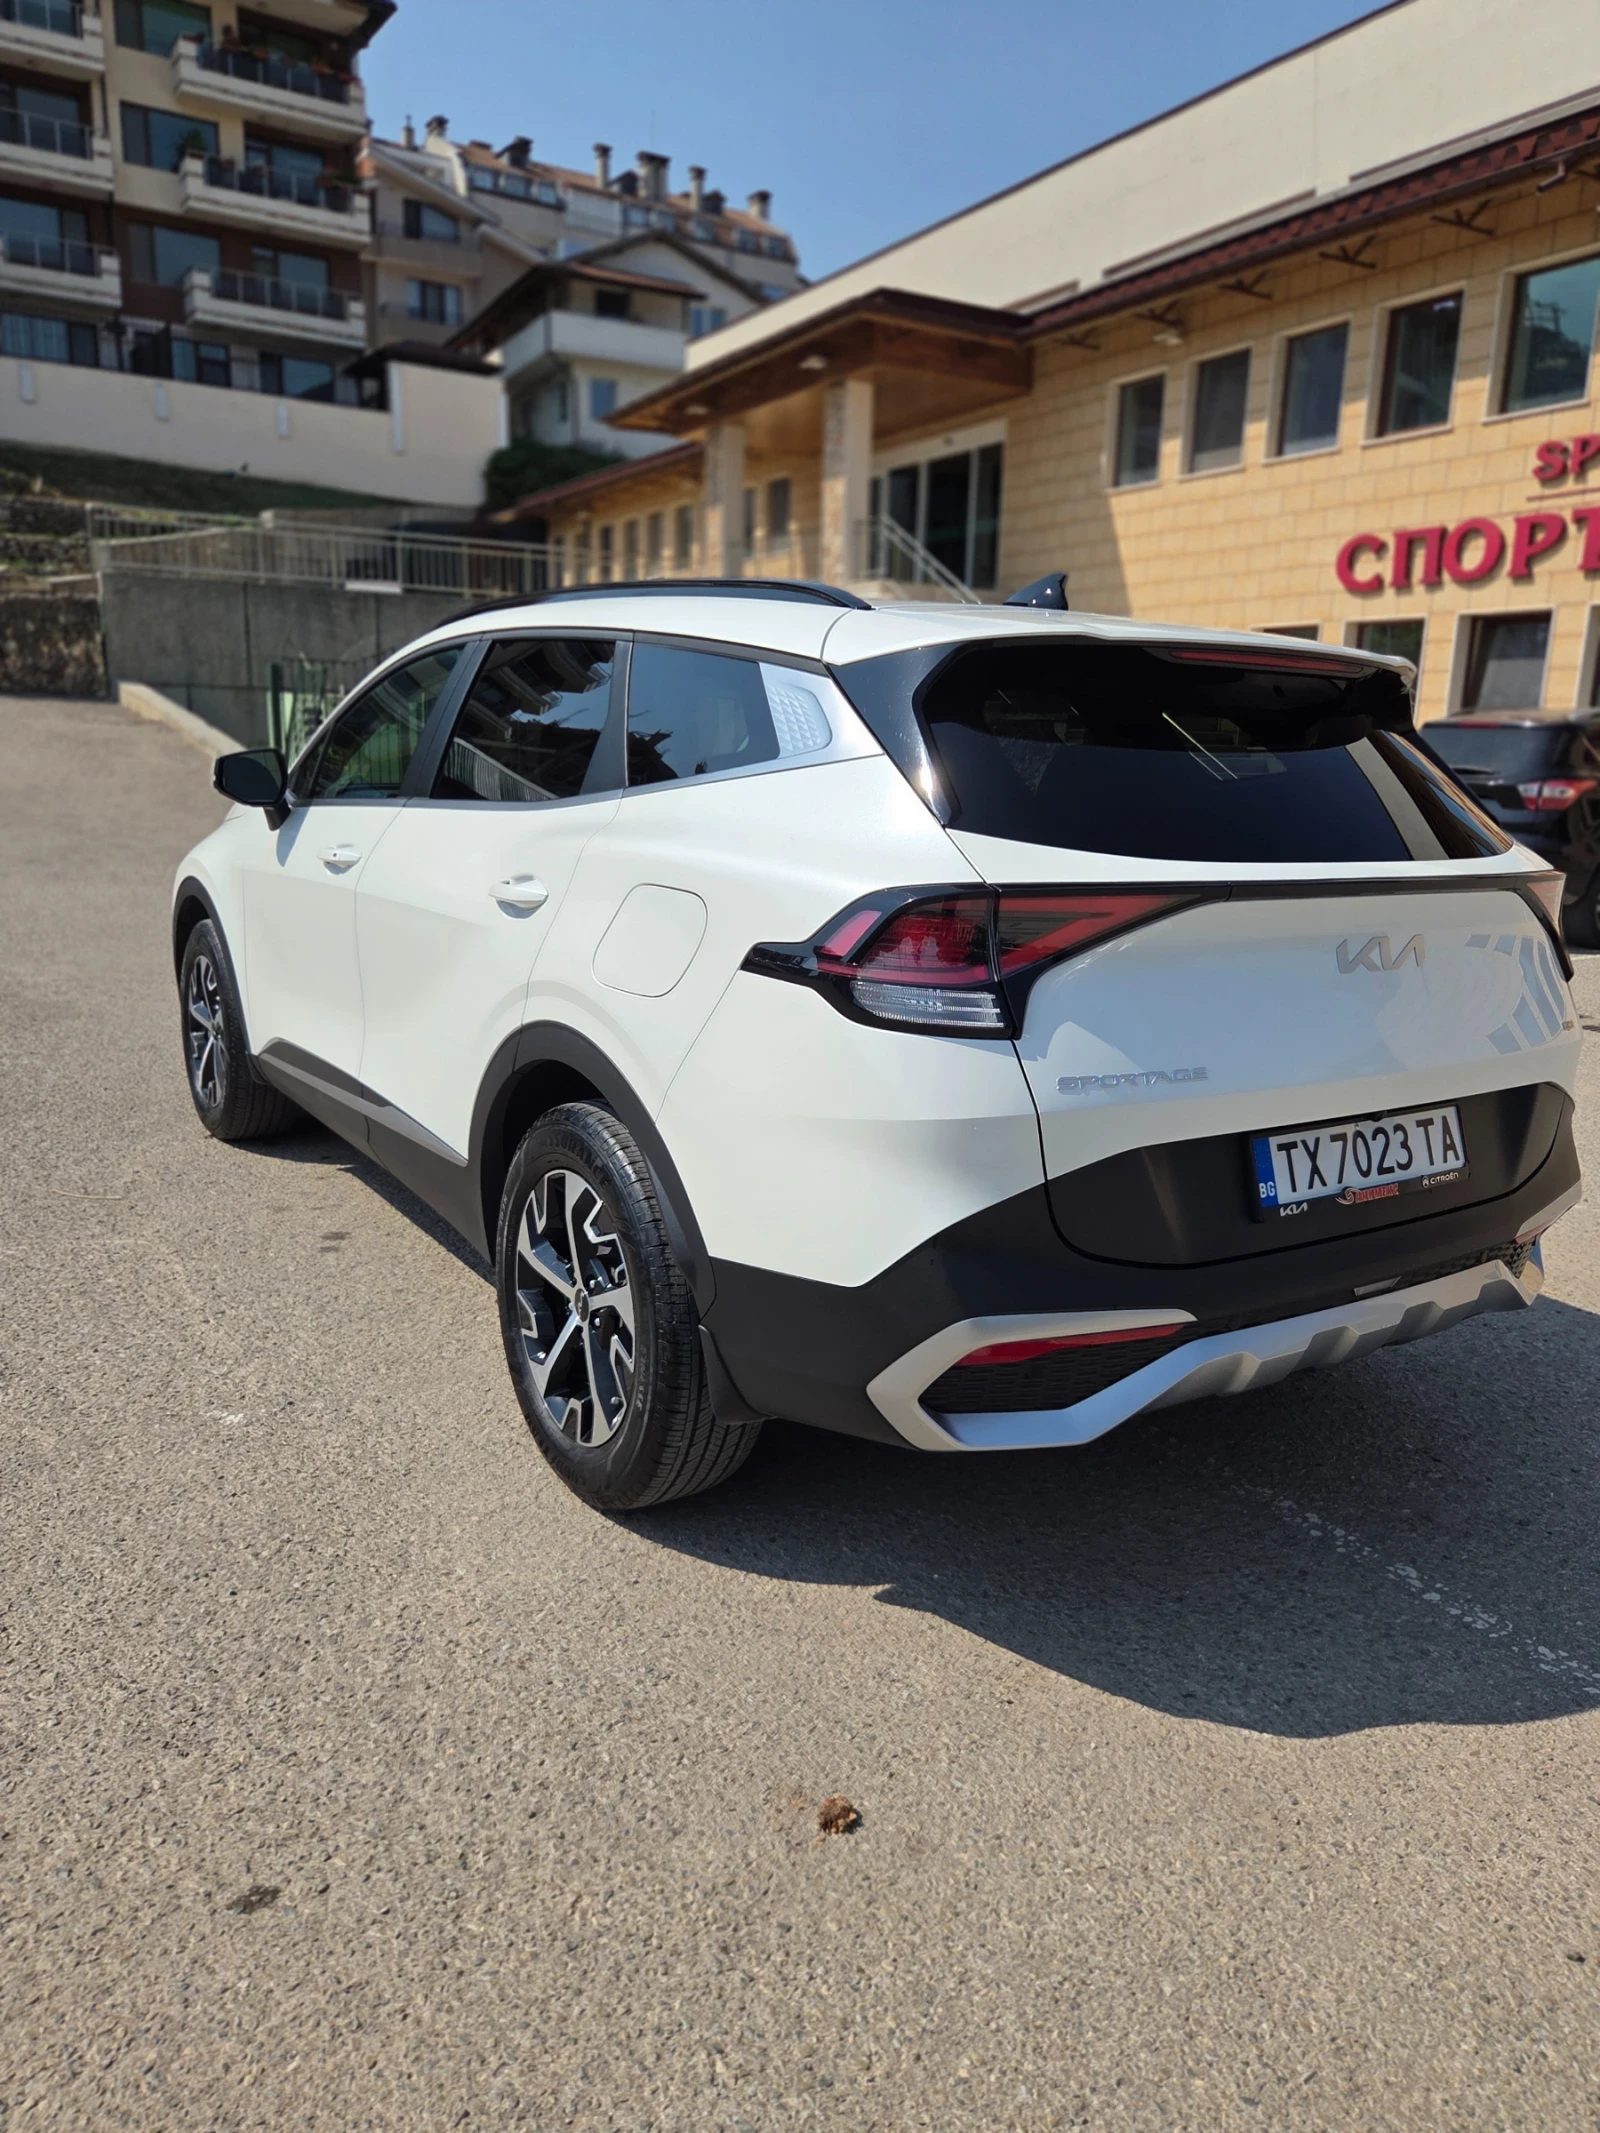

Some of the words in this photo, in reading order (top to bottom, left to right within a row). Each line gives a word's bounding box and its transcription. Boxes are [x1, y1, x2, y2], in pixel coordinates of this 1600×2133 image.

[1336, 506, 1600, 592] СПОРТ
[1336, 934, 1425, 974] KIA
[1056, 1067, 1208, 1091] SPORTAGE
[1259, 1182, 1276, 1198] BG
[1280, 1202, 1308, 1216] KIA
